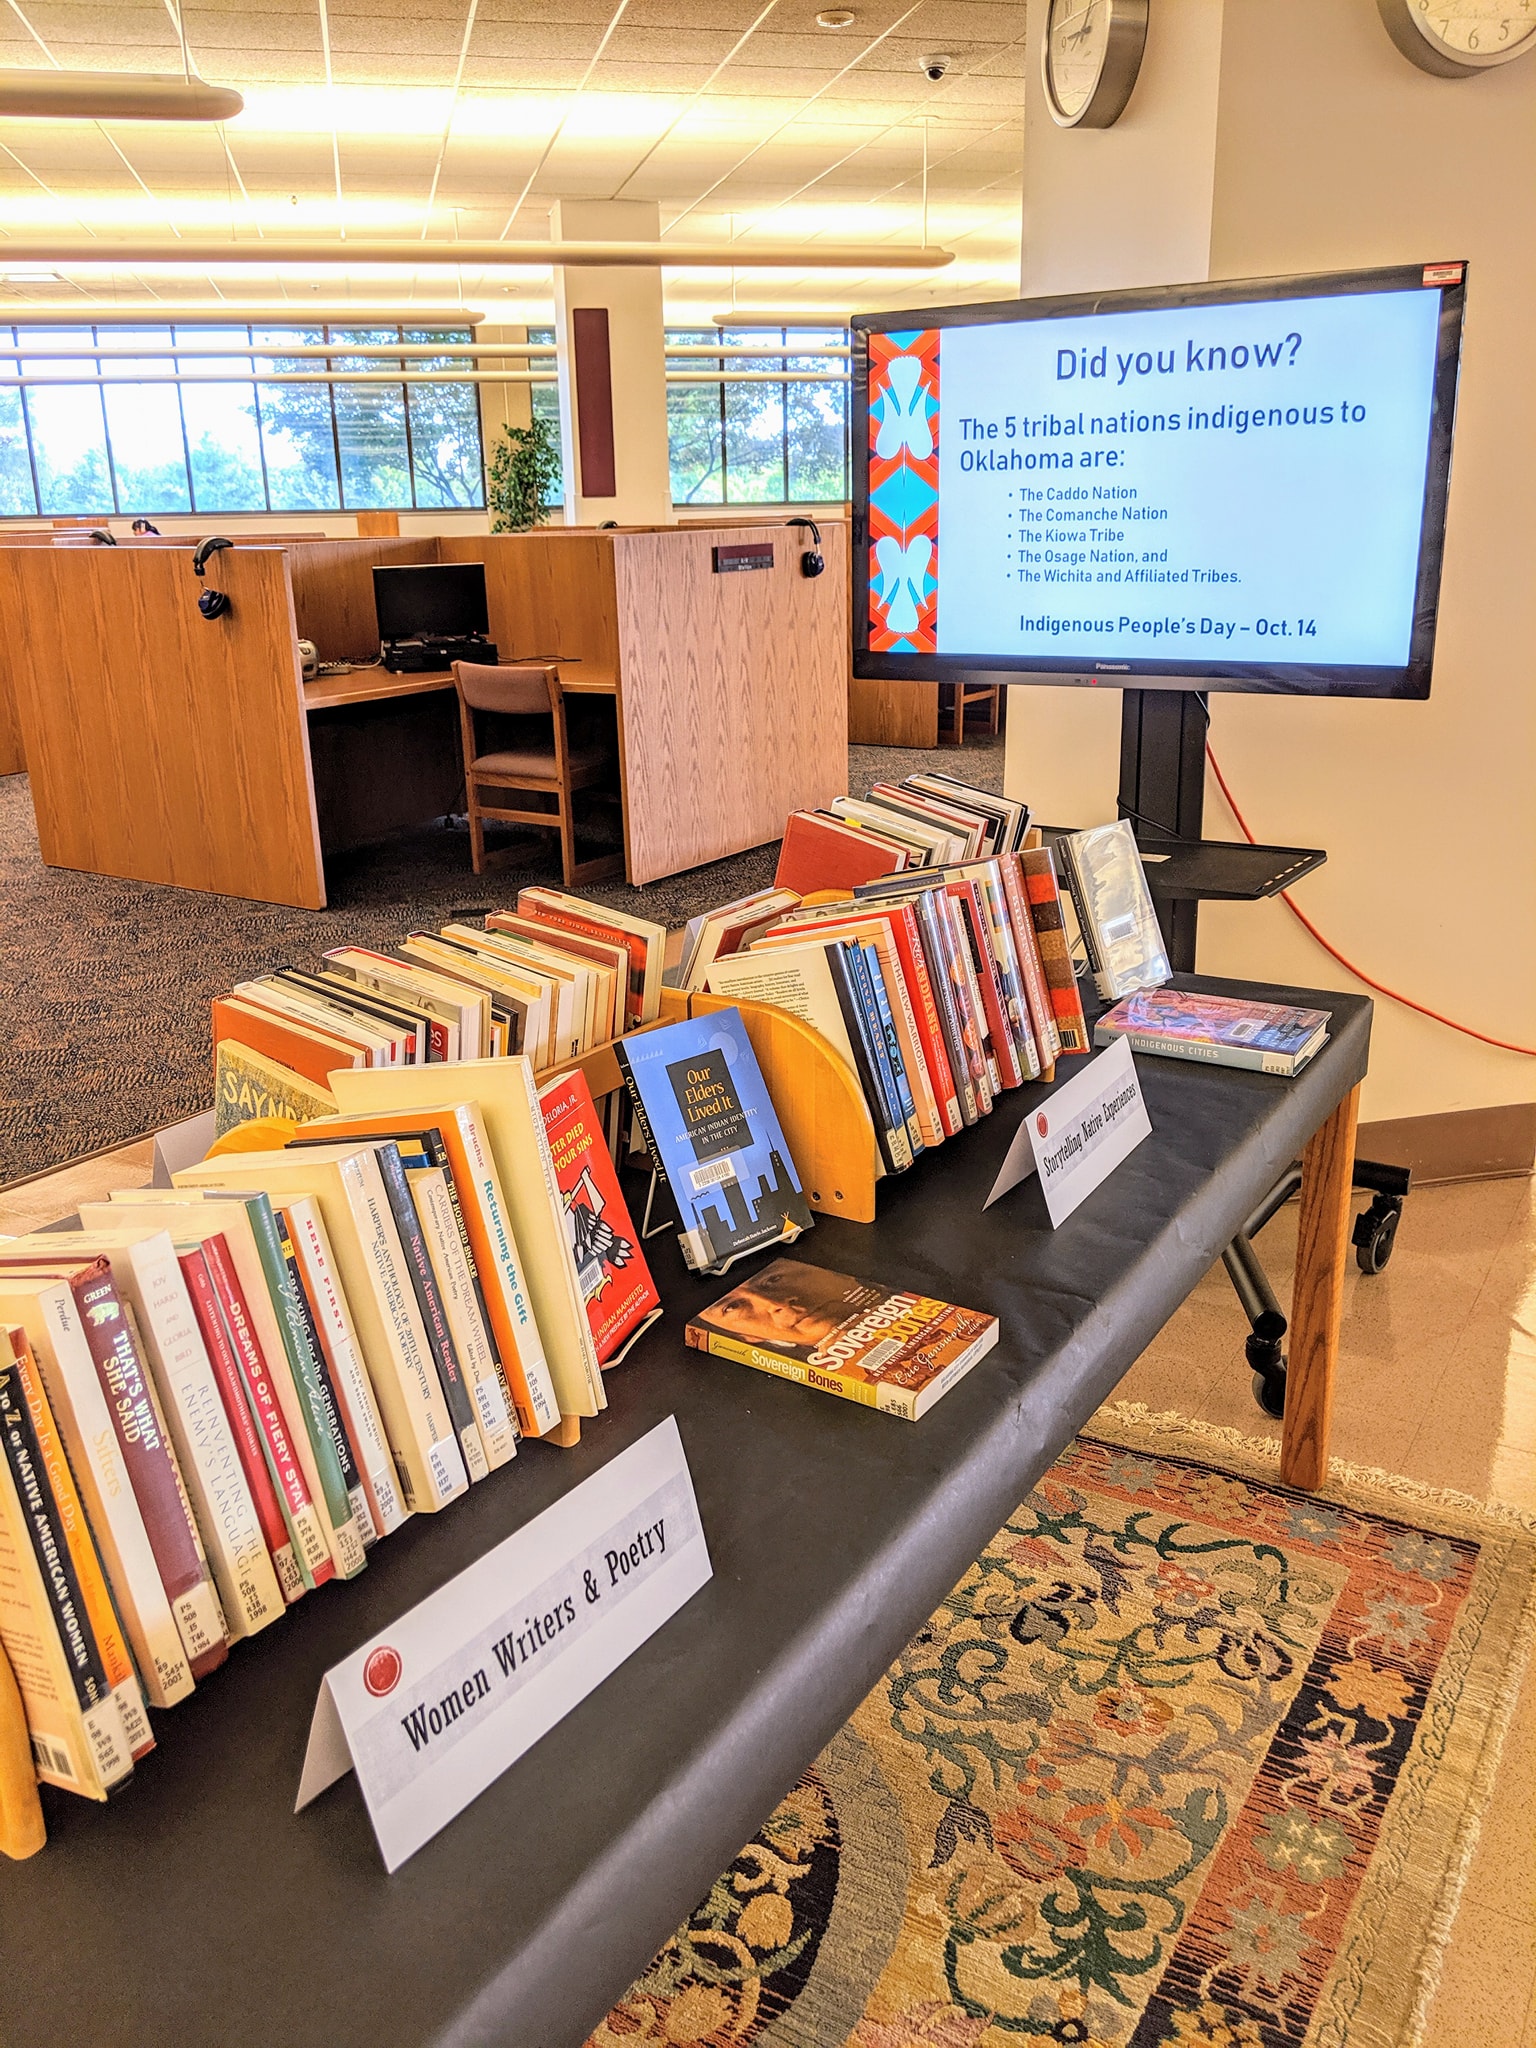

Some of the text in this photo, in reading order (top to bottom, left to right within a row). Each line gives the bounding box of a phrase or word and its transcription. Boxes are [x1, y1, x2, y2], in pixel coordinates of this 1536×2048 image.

[1468, 28, 1479, 50] 6
[1498, 20, 1510, 41] 5
[1056, 332, 1302, 385] Did you know?
[959, 400, 1366, 440] The 5 tribal nations indigenous to
[960, 447, 1125, 472] Oklahoma are:
[1019, 506, 1168, 522] The Comanche Nation
[1020, 486, 1137, 501] The Caddo Nation
[1018, 549, 1168, 565] The Osage Nation, and
[1019, 529, 1125, 542] The Kiowa Tribe
[1018, 569, 1242, 583] The Wichita and Affiliated Tribes.
[1020, 615, 1317, 639] Indigenous People's Day Oct. 14
[1096, 662, 1131, 671] Panasonic
[892, 961, 925, 1071] THE NEW WARRIORS
[1131, 1039, 1219, 1058] INDIGENOUS CITIES
[685, 1082, 725, 1104] Elders
[687, 1066, 711, 1085] Our
[624, 1075, 667, 1183] Our Elders Lived It
[675, 1107, 759, 1143] AMERICAN INDIAN IDENTITY
[687, 1096, 734, 1122] Lived It
[1043, 1083, 1137, 1177] Storytelling Native Experiences
[468, 1123, 484, 1167] Bruchac
[546, 1121, 586, 1158] TER DIED
[553, 1133, 595, 1172] YOUR SINS
[710, 1132, 722, 1141] THE
[724, 1125, 739, 1136] CITY
[426, 1189, 441, 1229] Contemporary
[437, 1231, 447, 1250] Native
[442, 1252, 454, 1279] American
[446, 1180, 478, 1278] THE HORNED SNAKE
[434, 1184, 487, 1364] CARRIERS OF THE DREAM WHEEL
[481, 1180, 528, 1324] Returning the Gift
[84, 1284, 112, 1303] GREEN
[306, 1220, 343, 1329] HERE FIRST
[54, 1298, 71, 1332] Perdue
[367, 1197, 432, 1400] HARPER'S ANTHOLOGY OF 20TH CENTURY
[370, 1240, 415, 1369] NATIVE AMERICAN POETRY
[409, 1234, 459, 1382] Native American Reader
[595, 1283, 643, 1336] INDIAN MANIFESTO
[204, 1299, 221, 1339] LISTENING
[219, 1349, 230, 1365] OUR
[283, 1303, 314, 1373] Remain
[807, 1295, 917, 1371] Sovereign
[872, 1304, 954, 1378] NEW NATIVE AMERICAN WRITING
[113, 1330, 160, 1451] THAT'S WHAT
[228, 1301, 262, 1378] DREAMS
[255, 1380, 272, 1406] OF
[264, 1410, 291, 1463] FIERY
[751, 1350, 805, 1380] Sovereign
[808, 1368, 843, 1393] Bones
[893, 1365, 920, 1385] Eric
[5, 1408, 22, 1428] Z
[103, 1356, 141, 1444] SHE SAID
[305, 1336, 319, 1359] for
[312, 1360, 325, 1381] the
[319, 1383, 351, 1473] GENERATIONS
[10, 1430, 23, 1448] OF
[15, 1354, 35, 1397] Every
[30, 1400, 45, 1429] Day
[40, 1432, 51, 1445] Is
[49, 1461, 70, 1499] Good
[62, 1505, 77, 1532] Day
[181, 1384, 216, 1469] ENEMY'S
[14, 1449, 44, 1511] NATIVE
[92, 1429, 122, 1497] Sifters
[198, 1385, 262, 1561] REINVENTING THE
[33, 1511, 70, 1599] AMERICAN
[242, 1584, 256, 1598] 508
[248, 1604, 268, 1622] 1998
[59, 1601, 89, 1666] WOMEN
[401, 1519, 666, 1753] Women Writers & Poetry
[157, 1662, 168, 1673] 89
[163, 1673, 183, 1690] 2001
